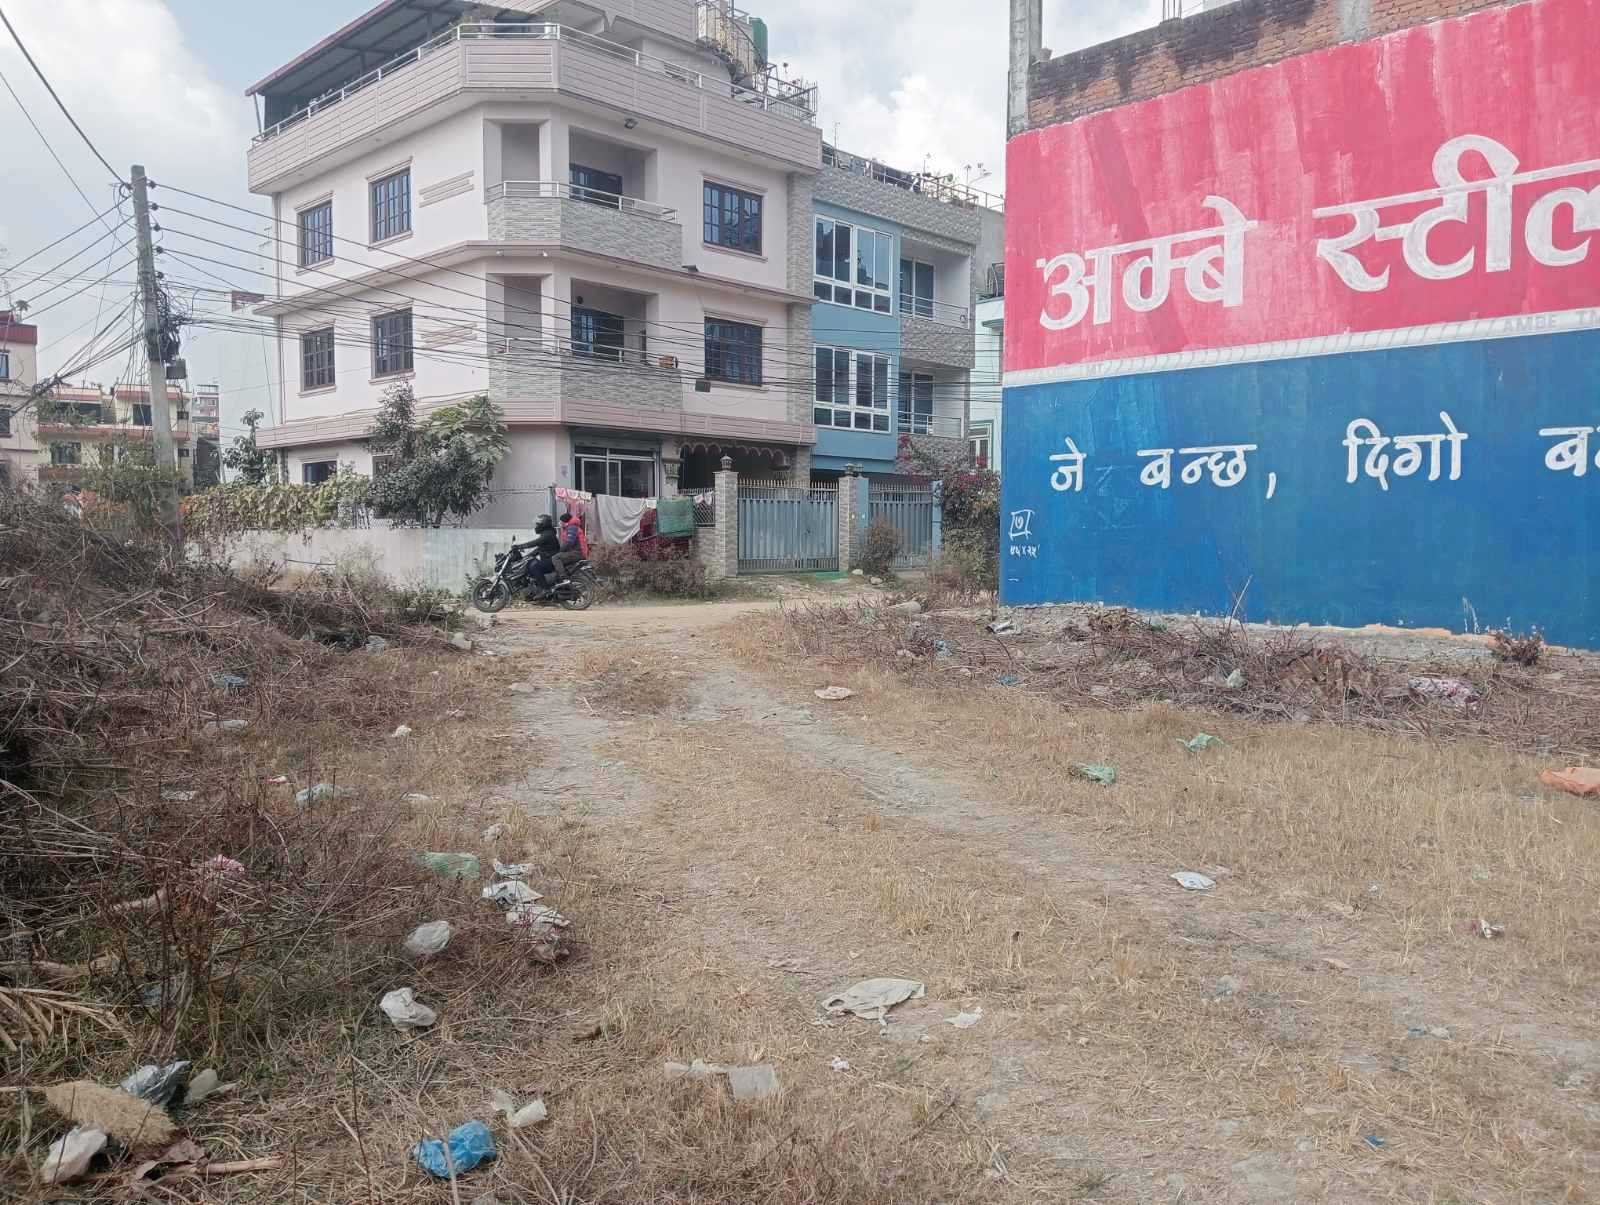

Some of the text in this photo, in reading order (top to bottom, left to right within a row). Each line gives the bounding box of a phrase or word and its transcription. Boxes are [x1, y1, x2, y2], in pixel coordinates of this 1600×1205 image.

[1036, 195, 1258, 331] अम्बे
[1503, 313, 1557, 333] AMBE
[1049, 411, 1600, 499] जे बन्छ, दिगो ब
